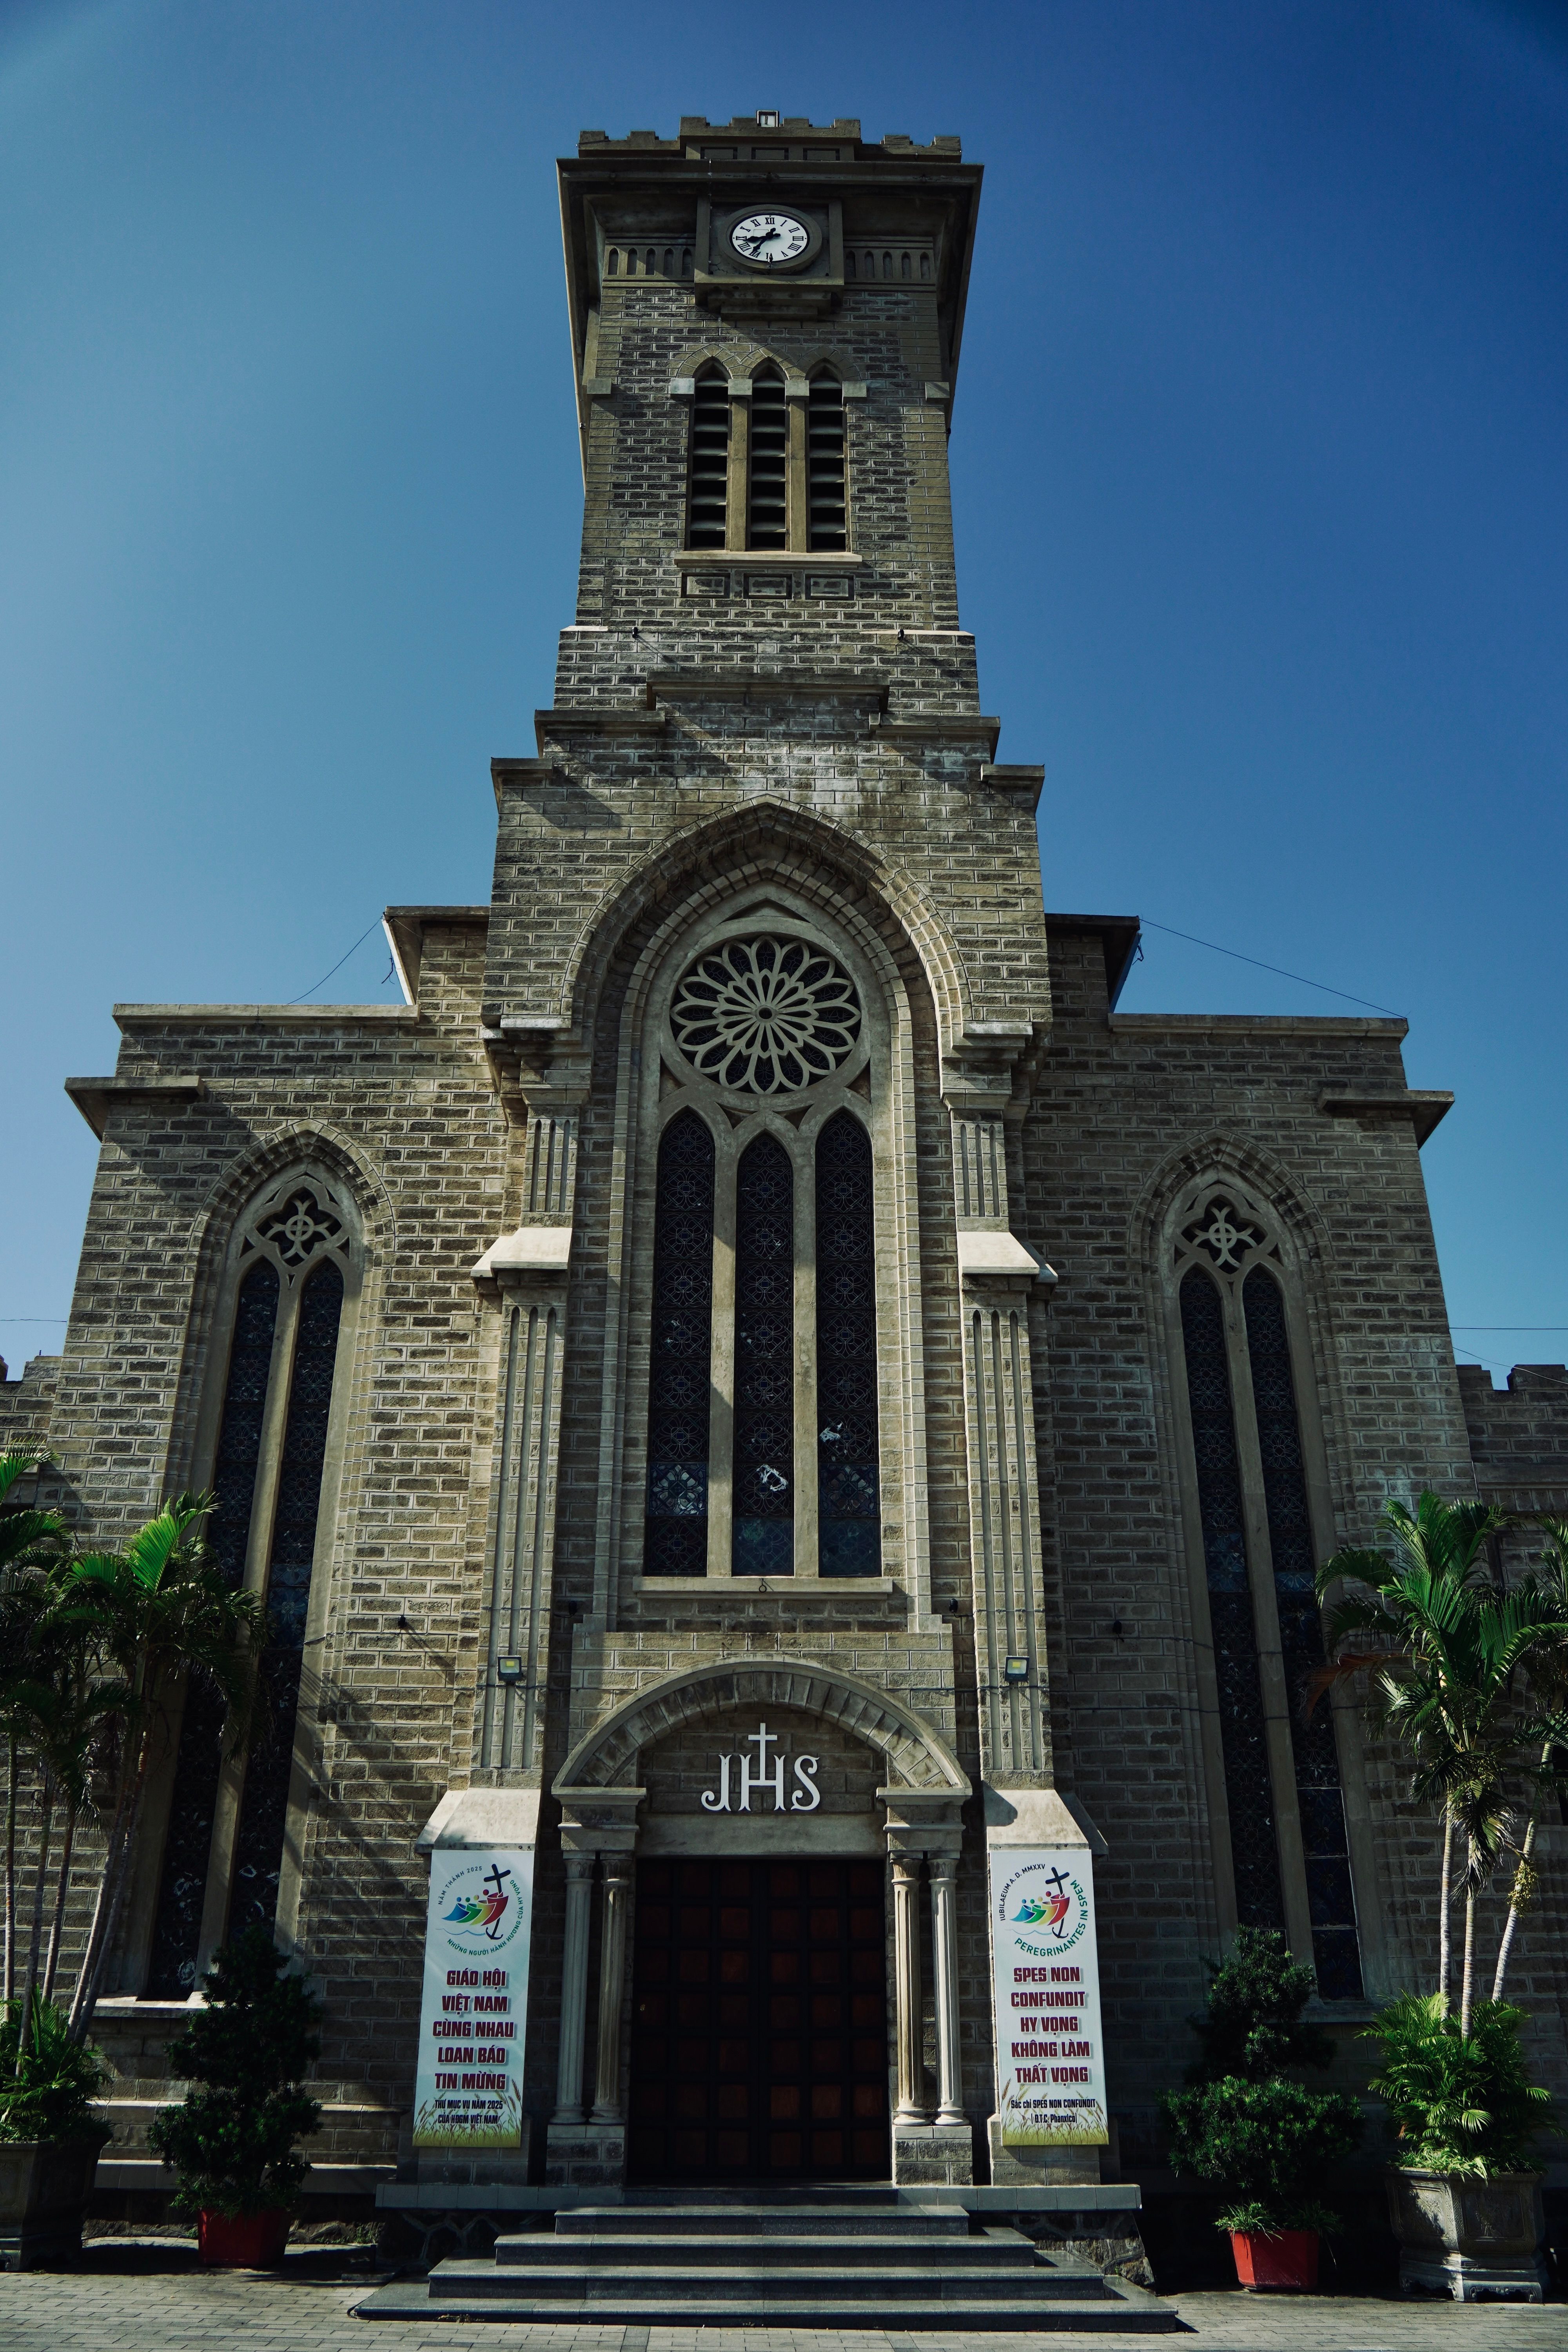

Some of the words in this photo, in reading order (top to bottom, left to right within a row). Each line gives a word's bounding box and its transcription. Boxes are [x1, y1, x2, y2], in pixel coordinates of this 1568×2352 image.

[750, 219, 761, 227] XI
[737, 242, 752, 252] VIII
[438, 1890, 447, 1905] NĂM
[445, 1871, 465, 1888] THÁNH
[999, 1883, 1011, 1921] IUBILAEUM
[1022, 1864, 1045, 1874] MMXXV
[1070, 1880, 1087, 1907] SPEM
[1080, 1910, 1088, 1920] IN
[447, 1938, 467, 1953] NHỮNG
[506, 1920, 521, 1942] HƯƠNG
[1014, 1922, 1085, 1956] PEREGRINANTES
[446, 1967, 479, 1985] GIÁO
[483, 1968, 506, 1990] HỘI
[1014, 1967, 1047, 1982] SPES
[1051, 1967, 1080, 1982] NON
[442, 1993, 470, 2015] VIỆT
[474, 1996, 508, 2012] NAM
[1011, 1991, 1085, 2007] CONFUNDIT
[433, 2018, 472, 2037] CÙNG
[475, 2022, 514, 2038] NHAU
[1020, 2017, 1038, 2032] HY
[1041, 2016, 1078, 2035] VỌNG
[438, 2047, 474, 2063] LOAN
[477, 2045, 506, 2063] BÁO
[1011, 2039, 1058, 2058] KHÔNG
[1062, 2039, 1090, 2057] LÀM
[435, 2073, 457, 2089] TIN
[461, 2071, 506, 2089] MỪNG
[1015, 2063, 1047, 2083] THẤT
[1051, 2067, 1089, 2086] VỌNG
[435, 2099, 446, 2109] THƯ
[447, 2100, 461, 2111] MỤC
[463, 2100, 470, 2111] VỤ
[472, 2098, 486, 2109] NĂM
[487, 2100, 503, 2109] 2025
[1011, 2099, 1022, 2109] Sắc
[1023, 2099, 1031, 2109] chỉ
[1033, 2100, 1047, 2108] SPES
[1049, 2099, 1062, 2108] NON
[1063, 2099, 1095, 2108] CONFUNDIT
[438, 2112, 449, 2123] CỦA
[470, 2113, 483, 2126] VIỆT
[484, 2115, 498, 2124] NAM
